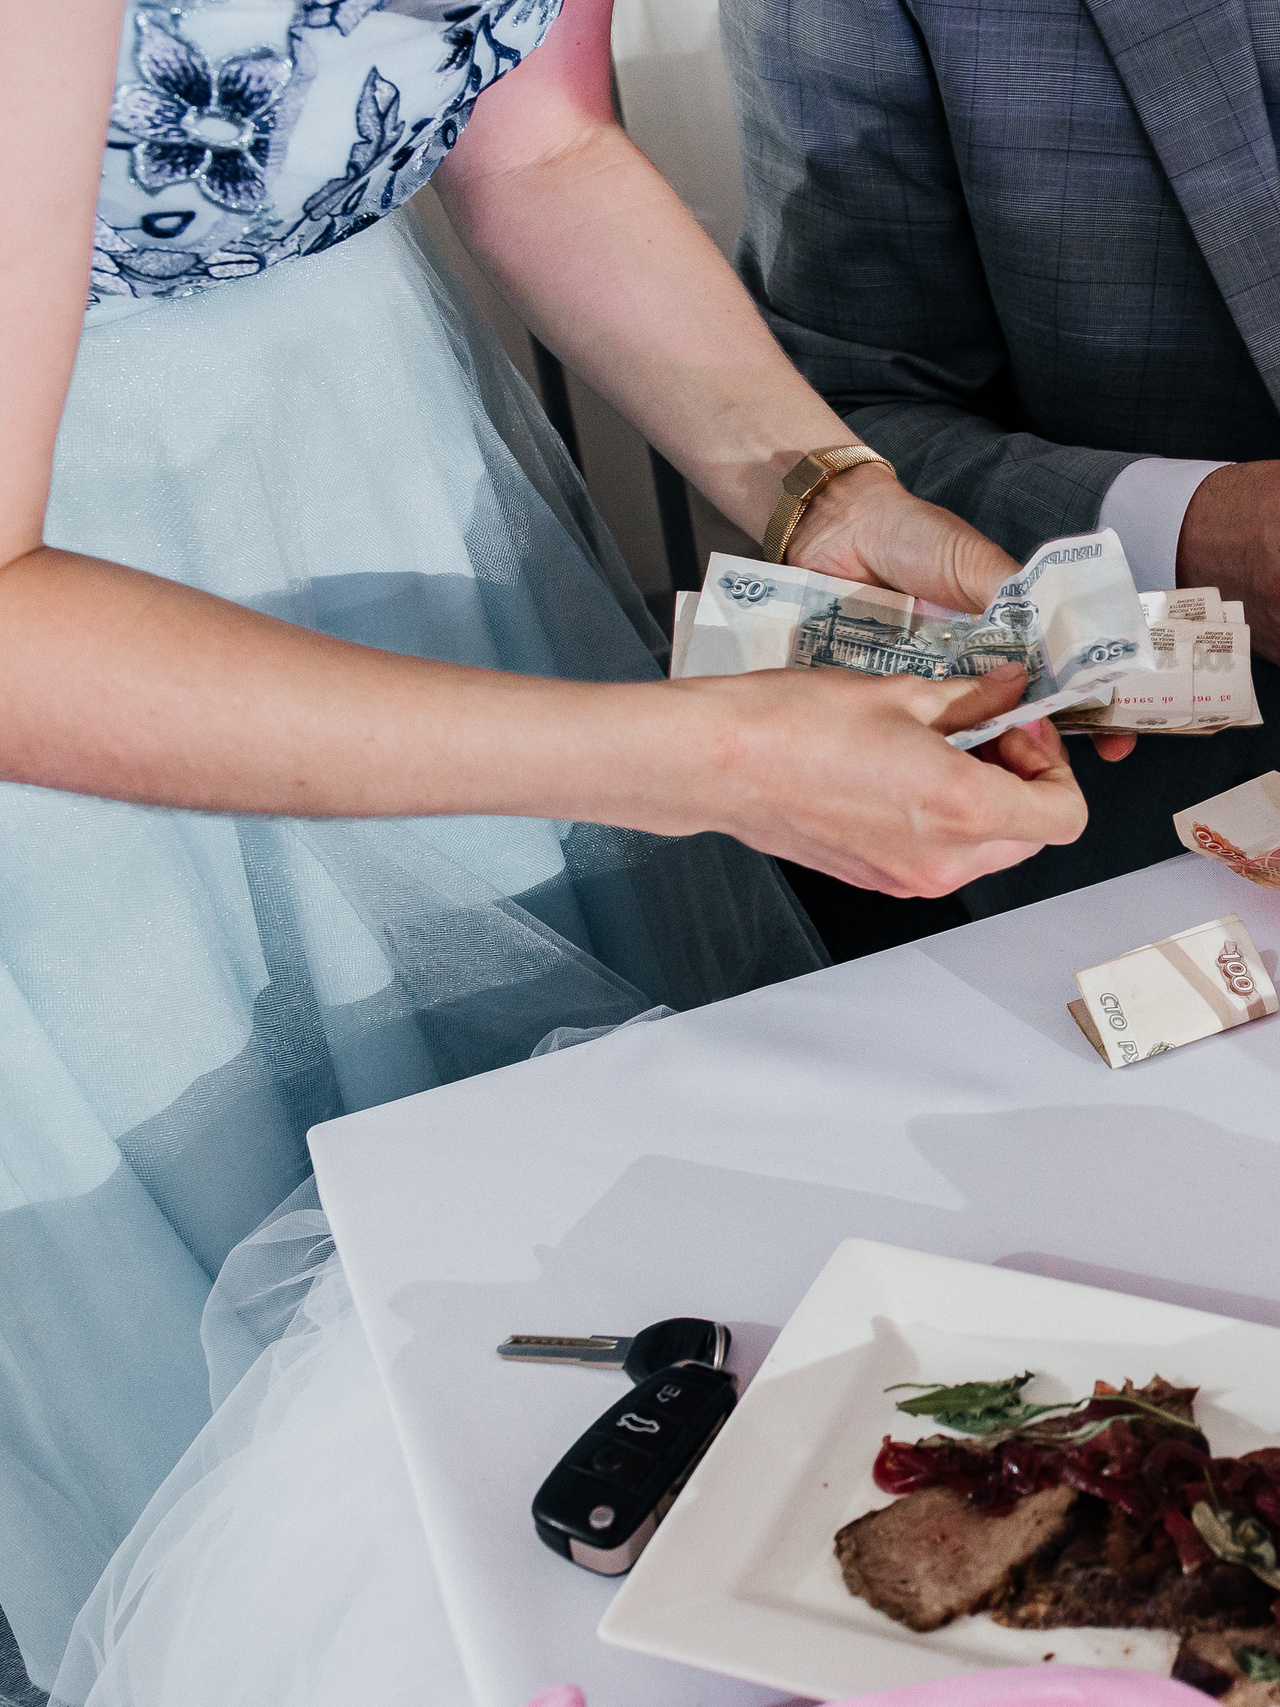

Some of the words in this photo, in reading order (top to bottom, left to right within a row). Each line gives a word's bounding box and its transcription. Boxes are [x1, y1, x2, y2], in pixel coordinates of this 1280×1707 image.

[730, 577, 768, 603] 50
[997, 543, 1102, 599] ПЯТЬДЕСЯТ
[1087, 641, 1124, 664] 50
[1195, 828, 1248, 863] 5000
[1218, 951, 1255, 995] 100
[1100, 992, 1128, 1031] СТО
[1117, 1040, 1140, 1064] РУ
